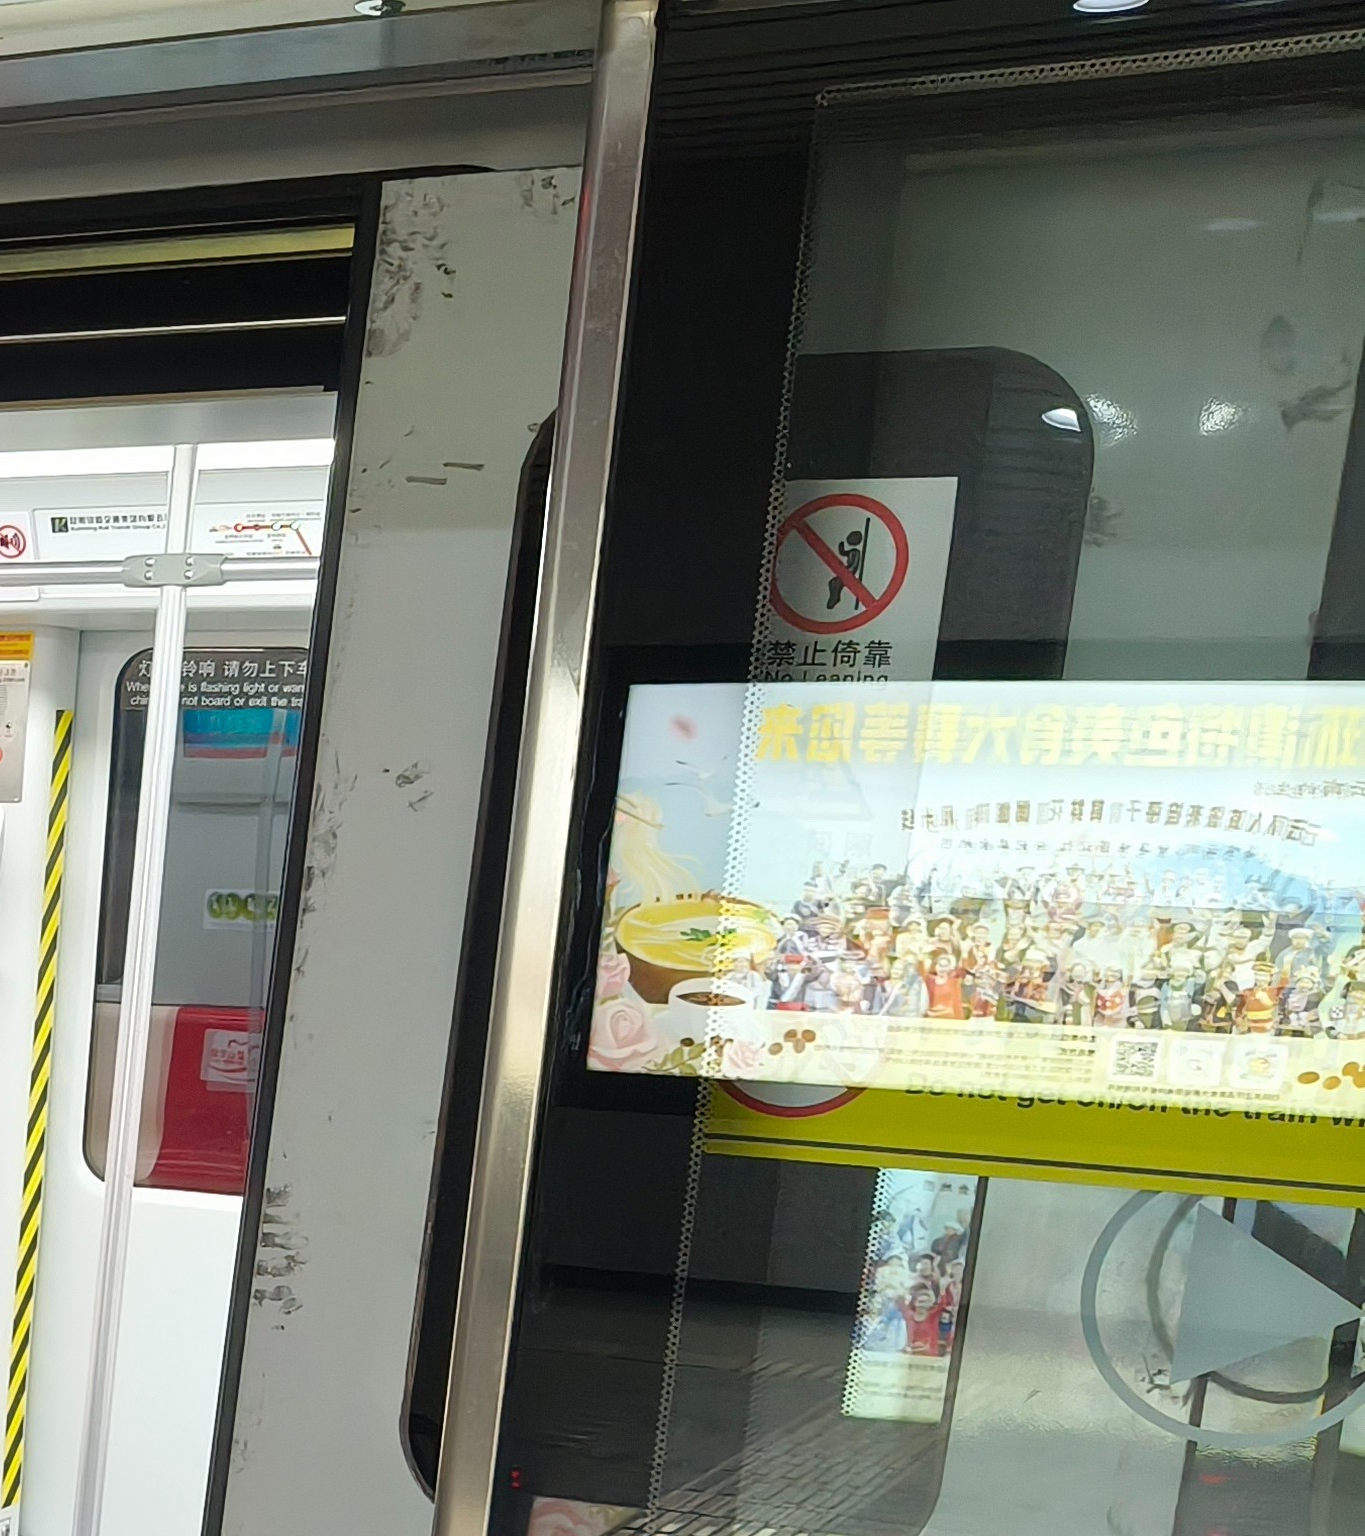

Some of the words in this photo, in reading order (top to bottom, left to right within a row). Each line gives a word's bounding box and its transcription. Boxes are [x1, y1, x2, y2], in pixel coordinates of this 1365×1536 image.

[766, 638, 893, 669] 禁止倚靠
[200, 681, 240, 695] flashing
